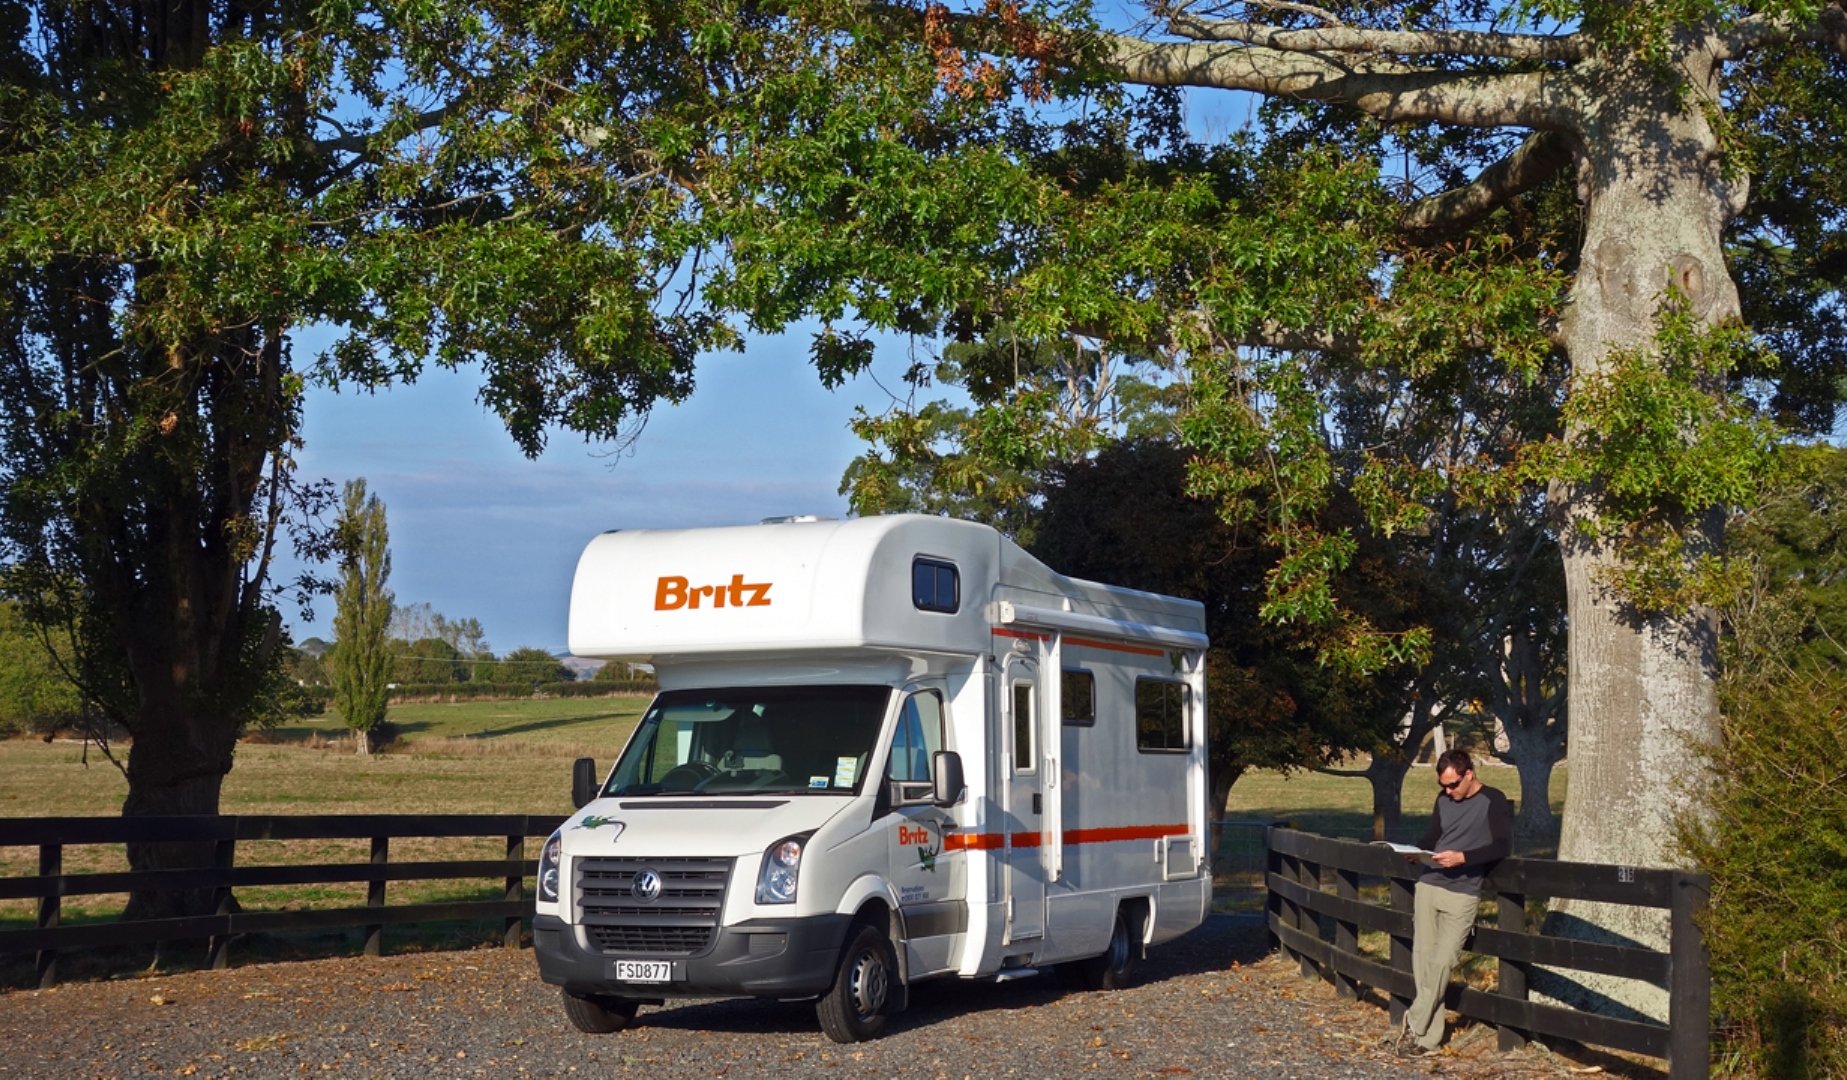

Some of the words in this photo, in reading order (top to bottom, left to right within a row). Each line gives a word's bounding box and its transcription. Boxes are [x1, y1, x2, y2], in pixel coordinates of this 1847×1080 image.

[654, 574, 773, 611] Britz
[898, 825, 929, 846] Britz
[618, 962, 669, 979] FSD877
